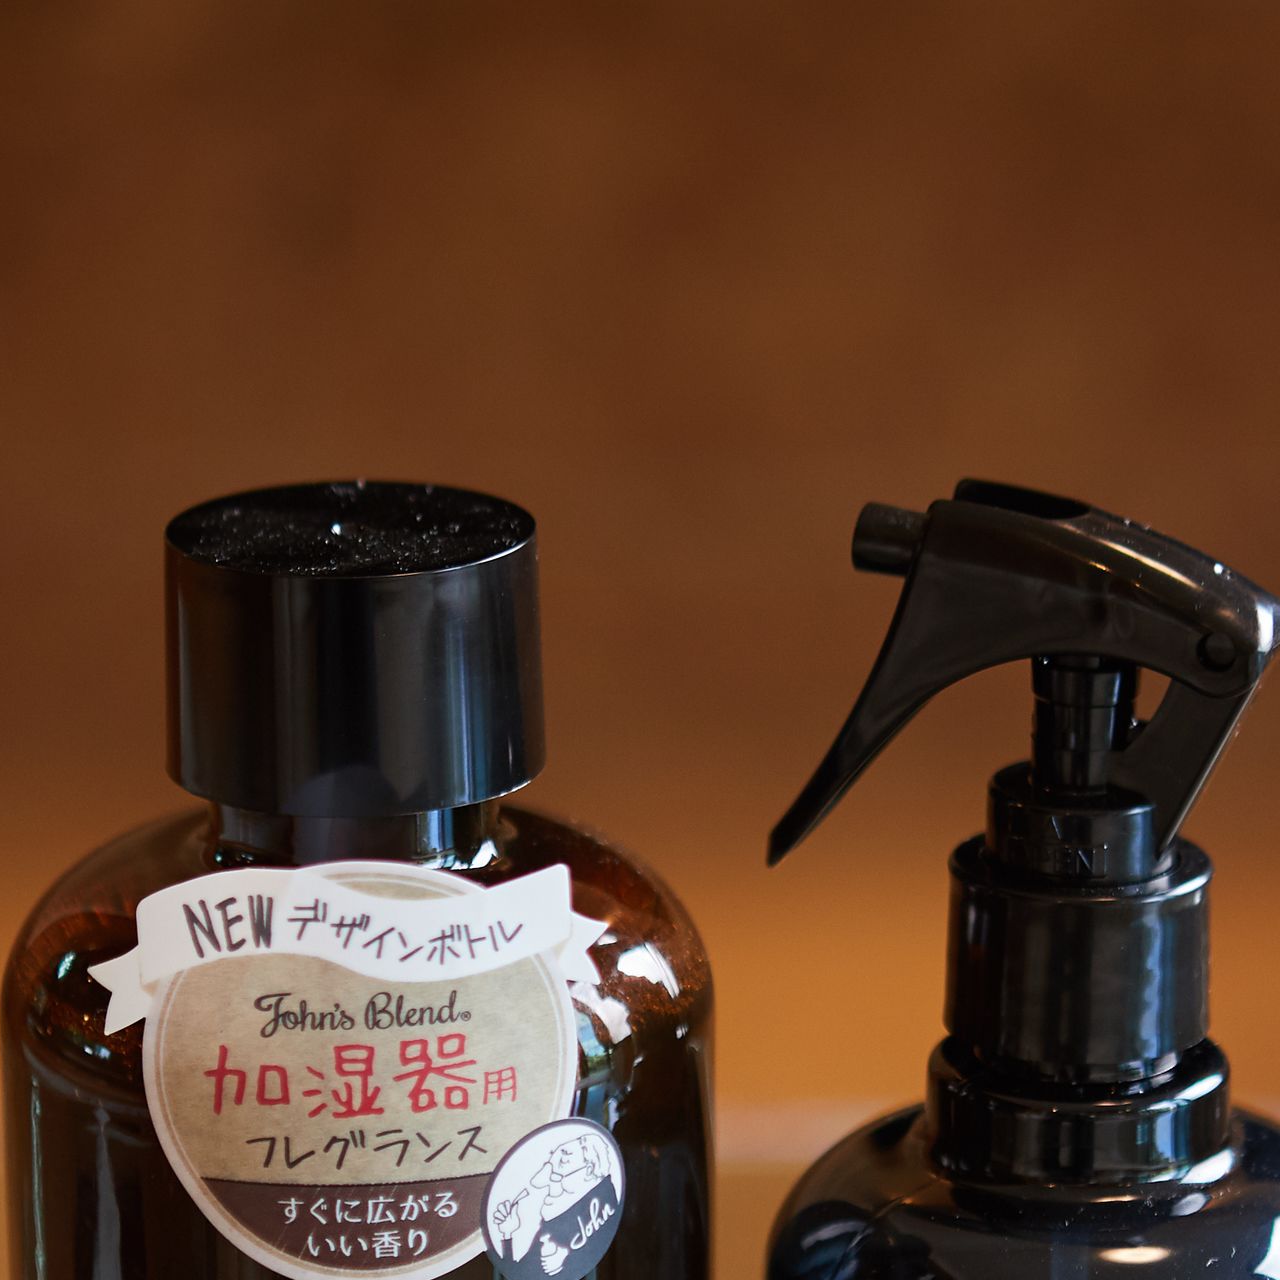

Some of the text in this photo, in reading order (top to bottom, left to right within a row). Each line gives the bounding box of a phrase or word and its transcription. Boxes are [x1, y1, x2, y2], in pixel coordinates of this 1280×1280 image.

[182, 894, 523, 965] NEW デザインボトル
[253, 992, 356, 1039] John's
[203, 1032, 517, 1119] 加湿器用
[245, 1125, 488, 1171] フレグランス
[278, 1190, 460, 1226] すぐに広がる
[569, 1197, 616, 1250] John
[306, 1229, 429, 1260] いい香り
